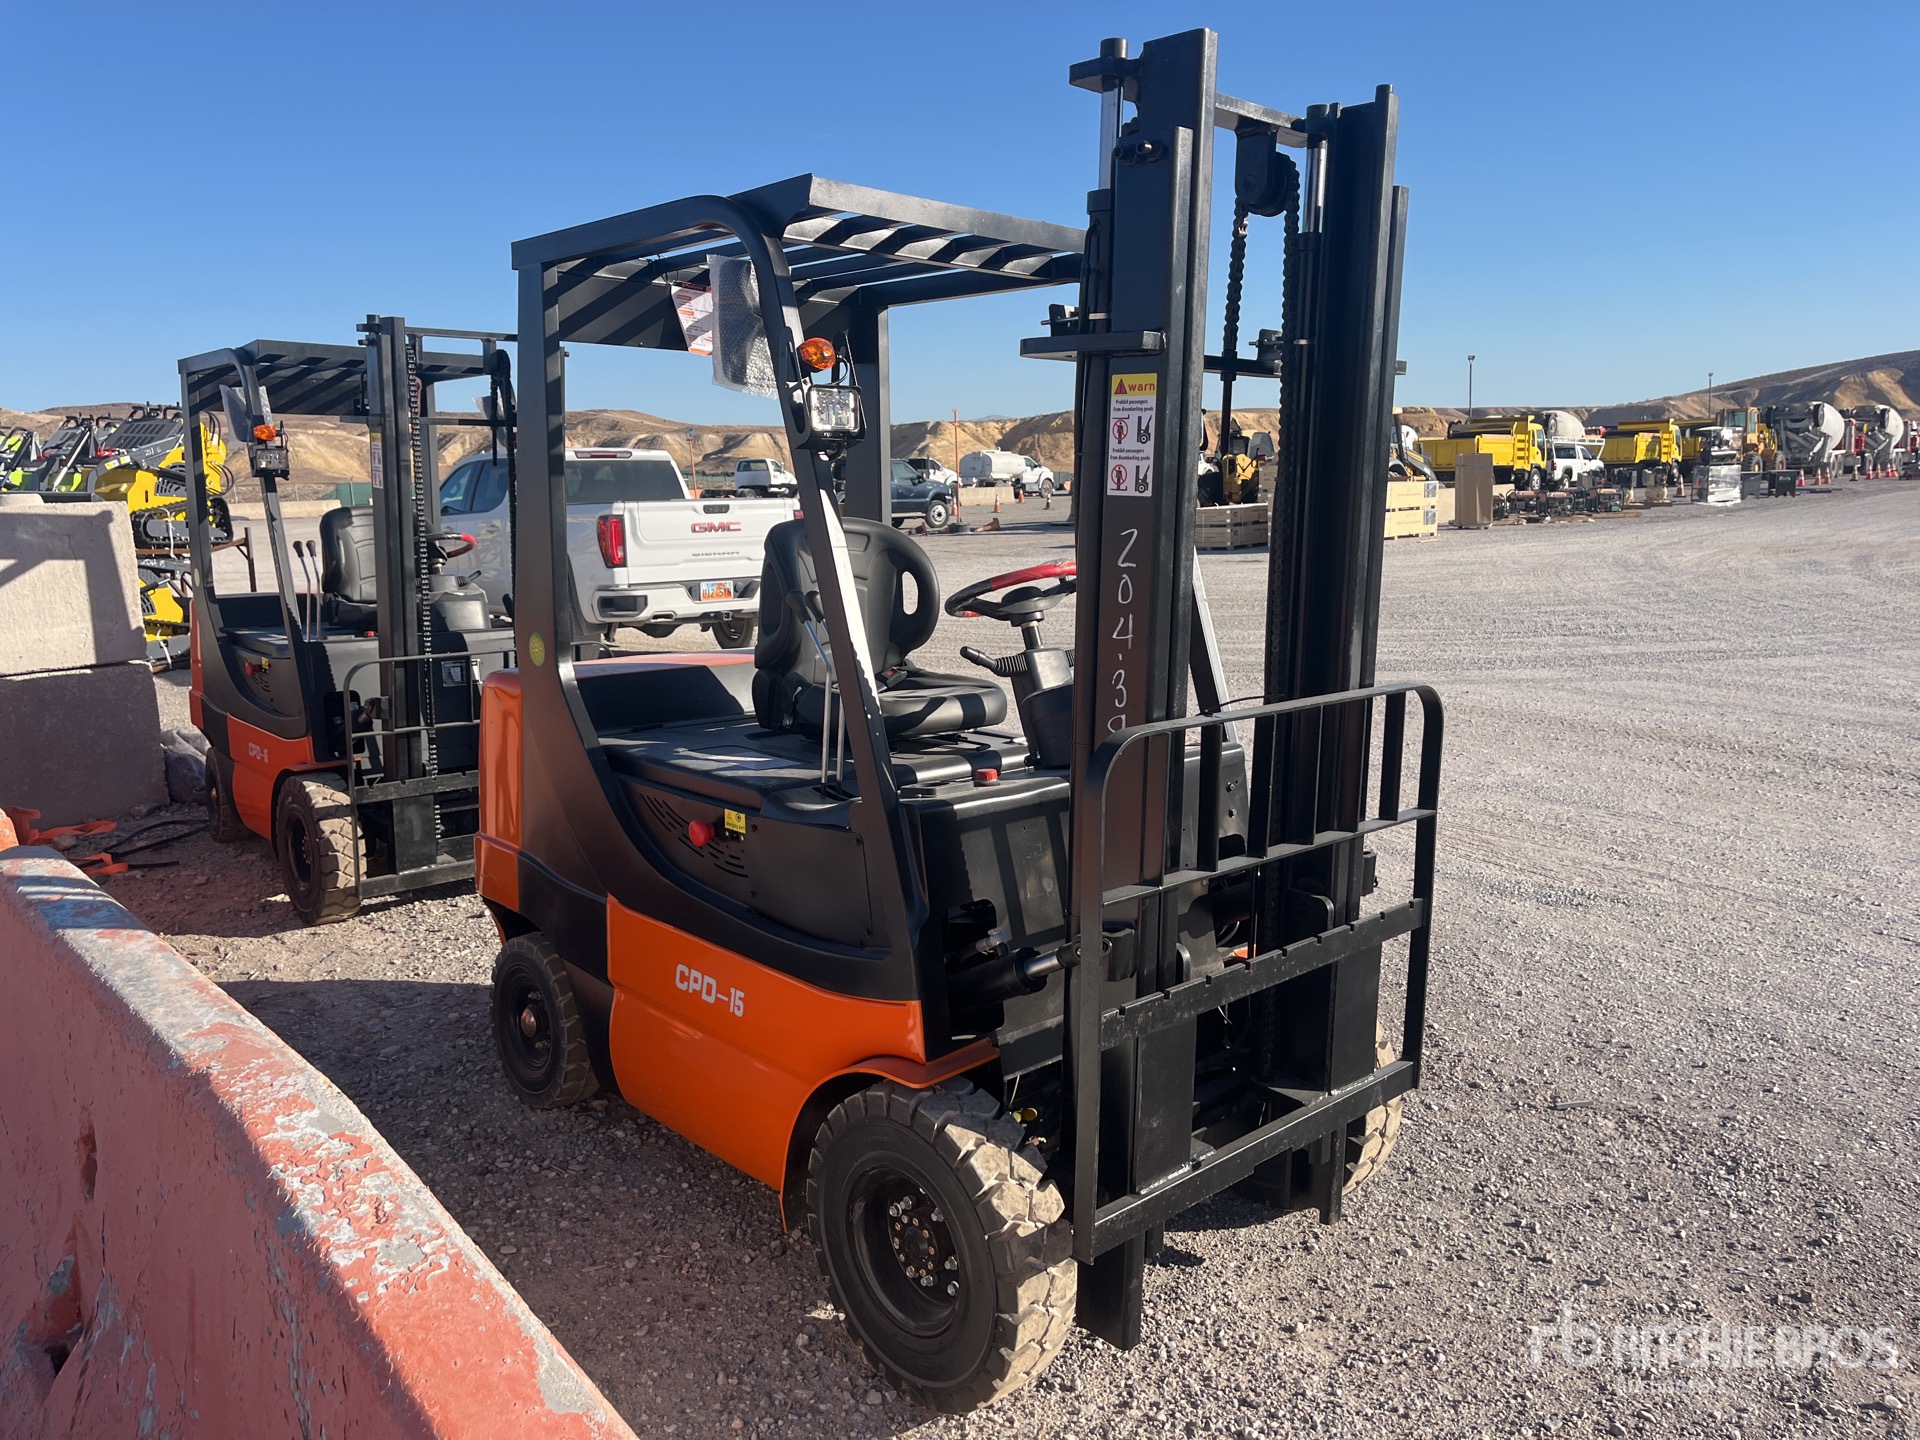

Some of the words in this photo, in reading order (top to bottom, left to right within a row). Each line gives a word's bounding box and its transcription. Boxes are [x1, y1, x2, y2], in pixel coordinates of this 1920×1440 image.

[1128, 383, 1155, 392] warn
[691, 522, 741, 533] GMC
[675, 963, 745, 1018] CPD-15
